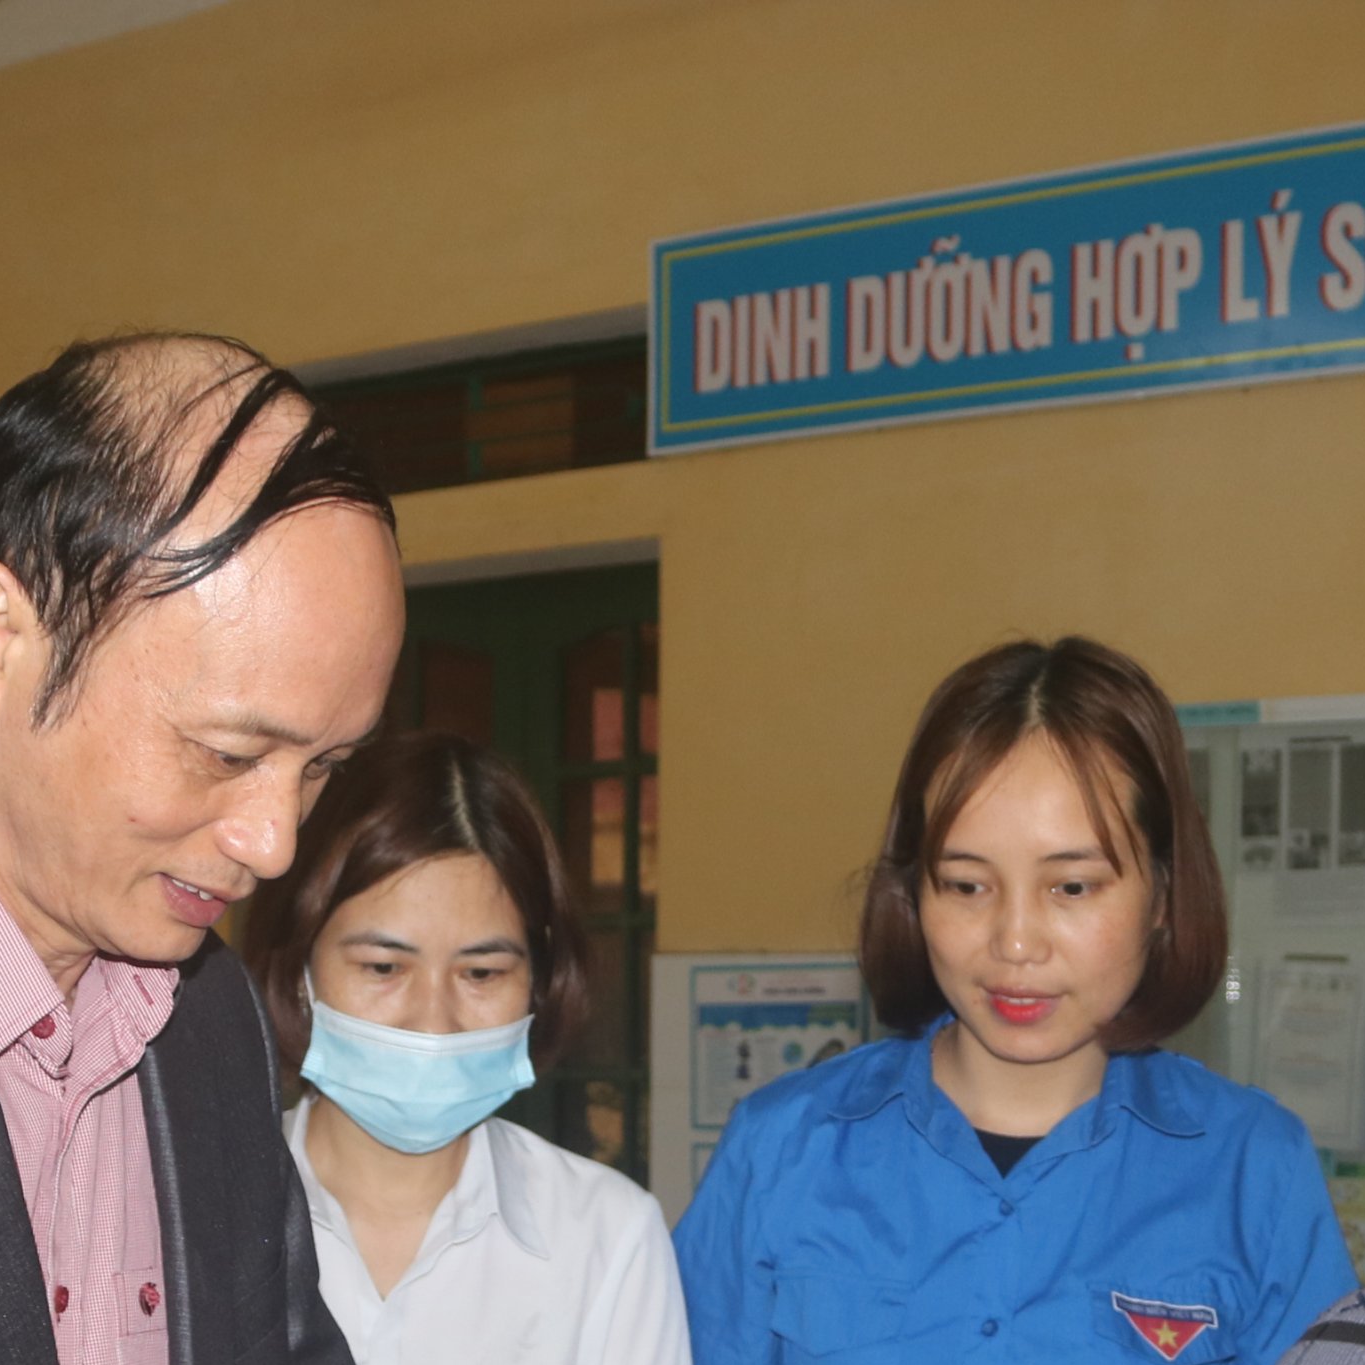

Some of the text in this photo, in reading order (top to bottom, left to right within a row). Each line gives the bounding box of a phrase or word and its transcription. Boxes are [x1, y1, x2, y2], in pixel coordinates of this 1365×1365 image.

[695, 283, 830, 394] DINH
[845, 235, 1053, 374] DƯỠNG
[1071, 223, 1203, 361] HỢP
[1221, 188, 1302, 324] LÝ
